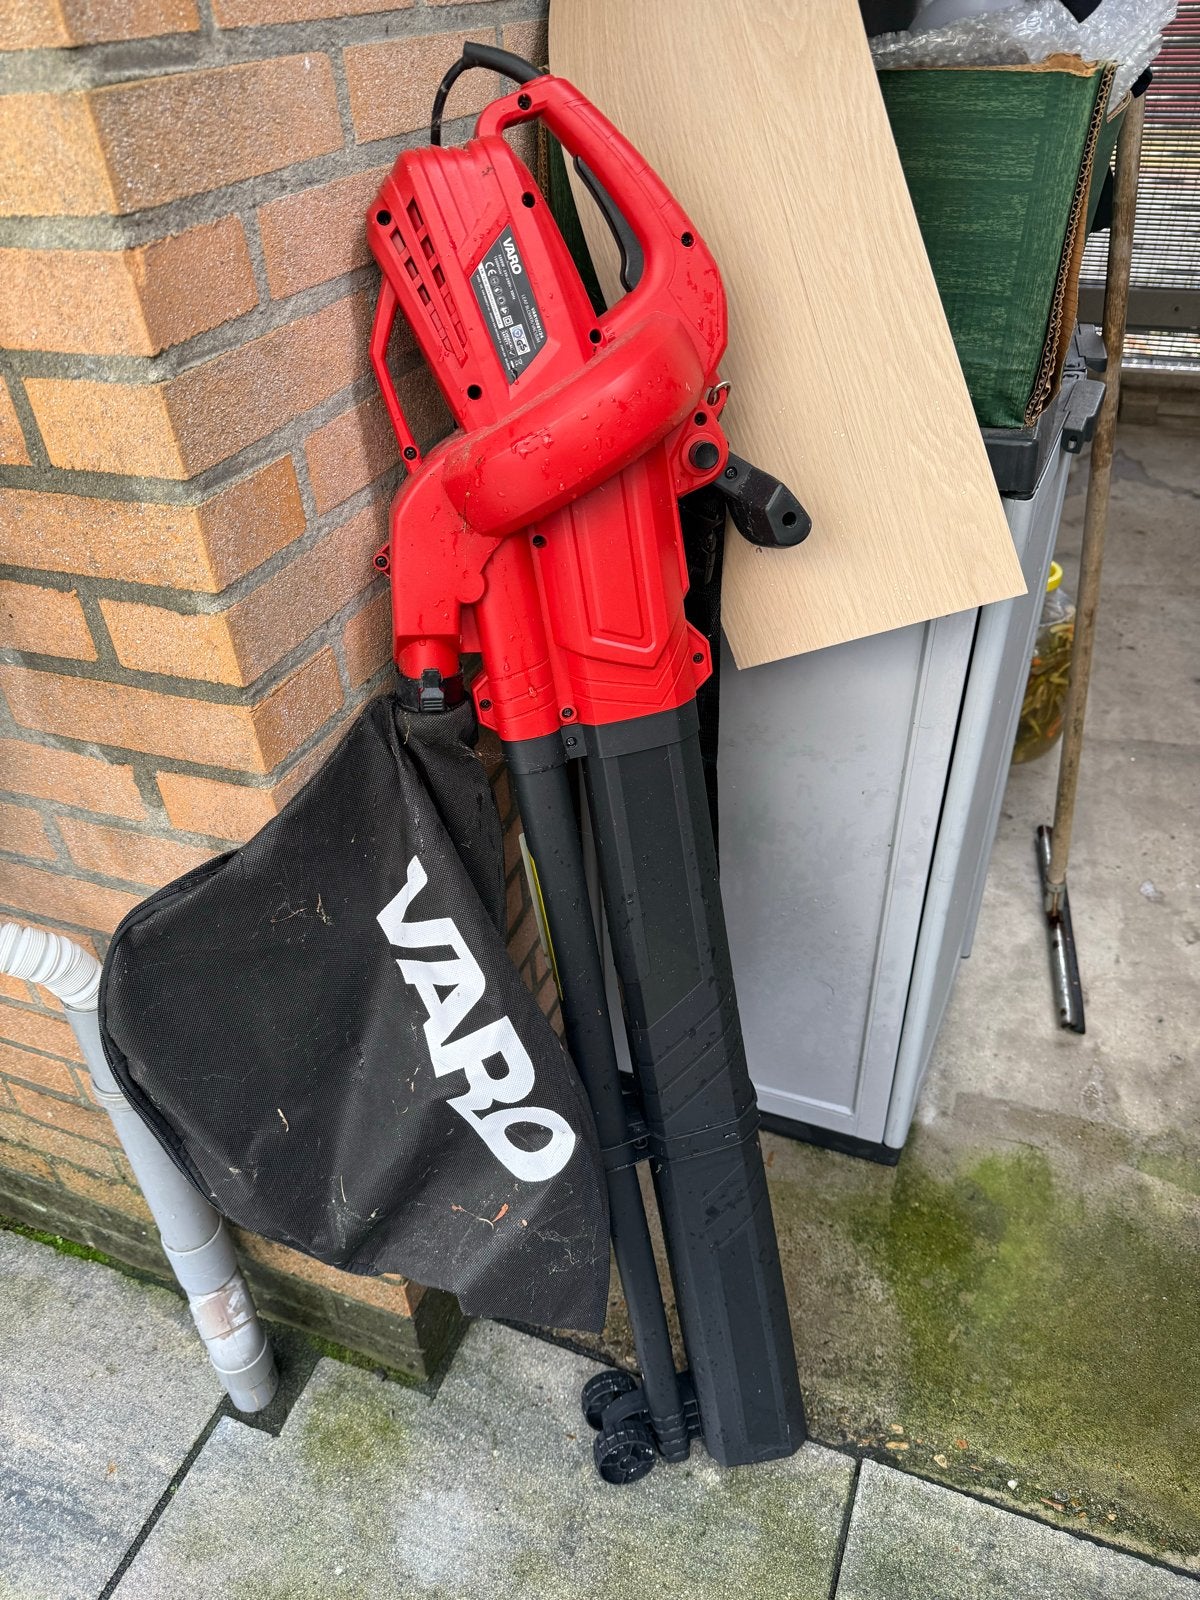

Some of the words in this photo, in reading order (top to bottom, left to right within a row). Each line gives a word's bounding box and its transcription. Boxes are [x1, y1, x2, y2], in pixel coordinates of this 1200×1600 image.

[502, 237, 522, 275] VARO
[516, 338, 527, 352] GS
[376, 855, 576, 1182] VARO
